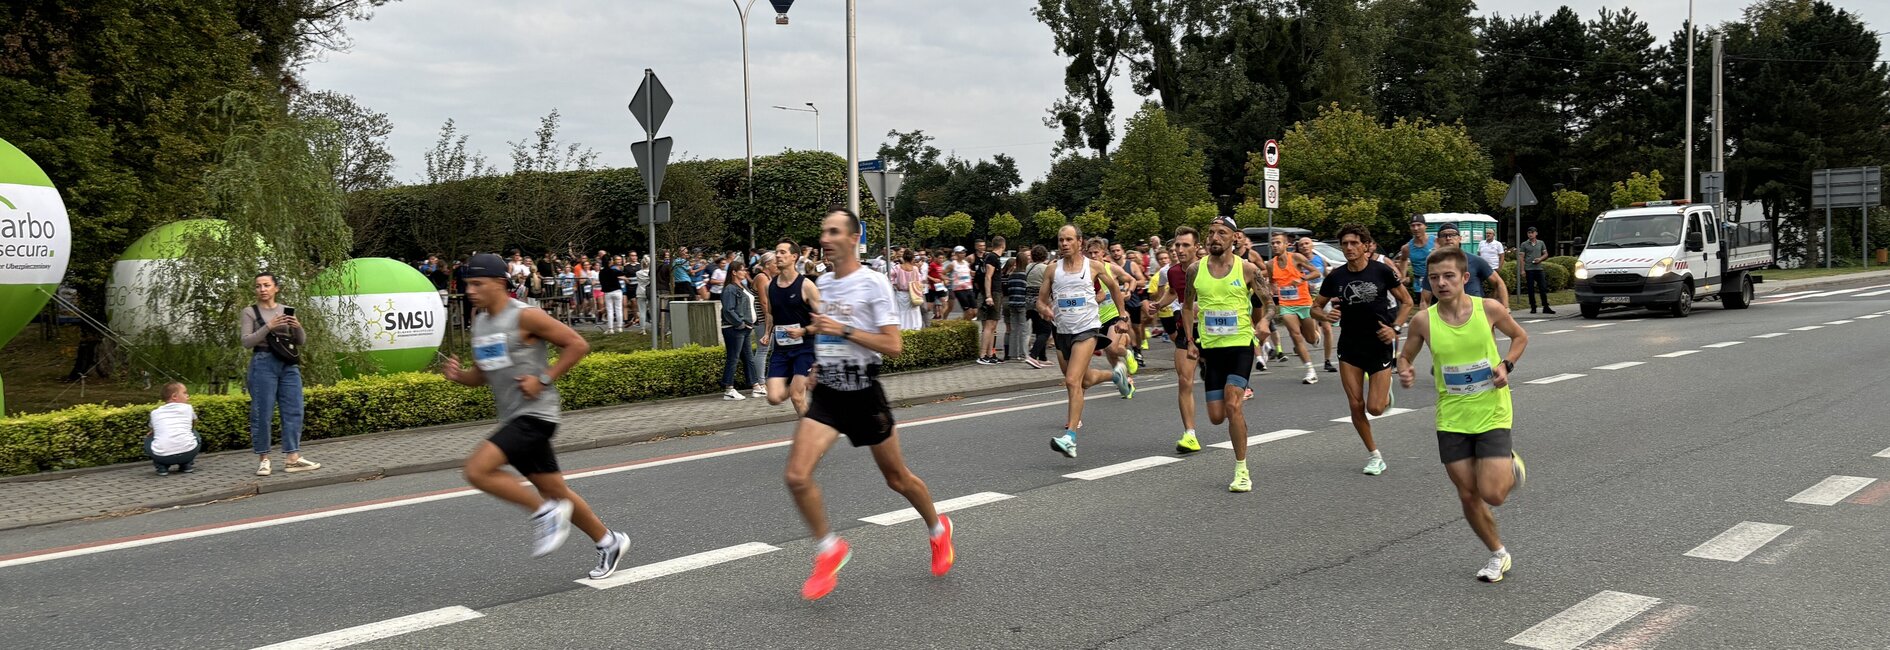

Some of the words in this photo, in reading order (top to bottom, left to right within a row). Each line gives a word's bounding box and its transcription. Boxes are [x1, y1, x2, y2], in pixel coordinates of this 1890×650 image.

[1066, 299, 1077, 307] 98
[384, 311, 434, 331] SMSU
[1214, 318, 1227, 326] 191
[1464, 374, 1473, 383] 3
